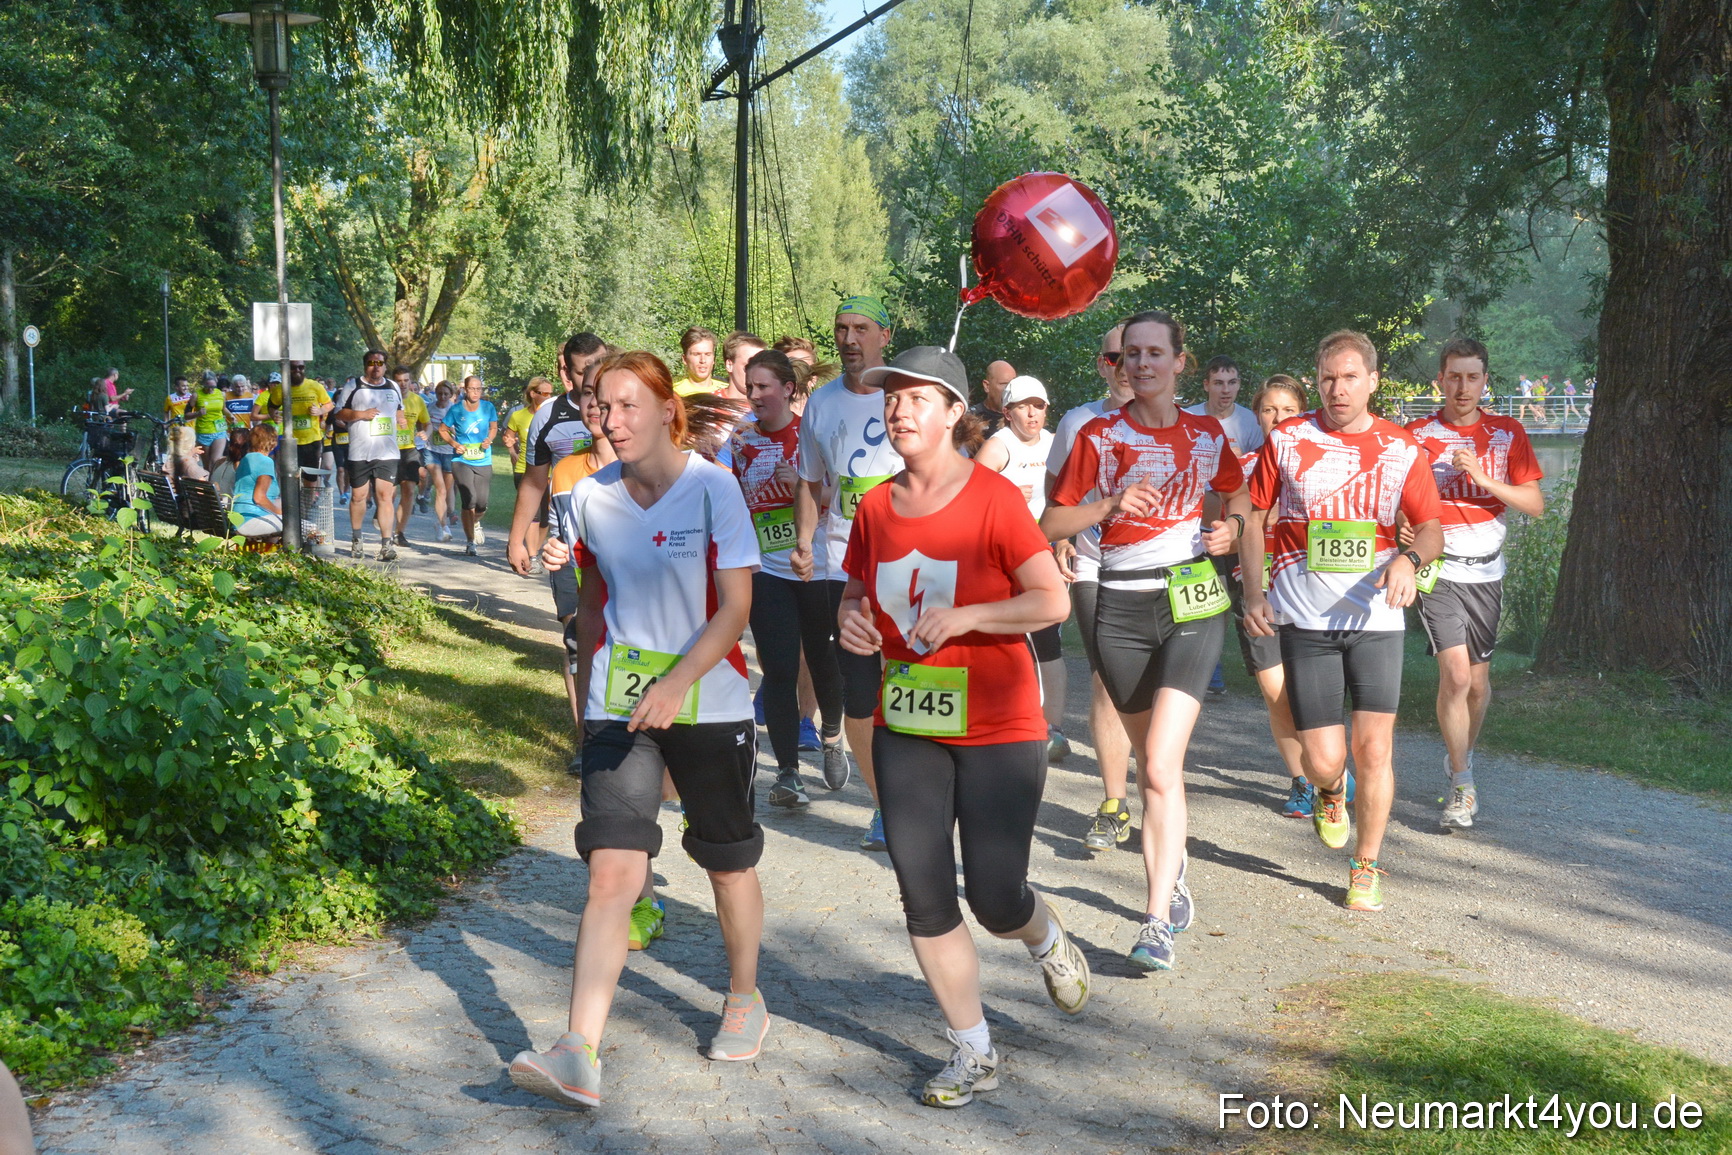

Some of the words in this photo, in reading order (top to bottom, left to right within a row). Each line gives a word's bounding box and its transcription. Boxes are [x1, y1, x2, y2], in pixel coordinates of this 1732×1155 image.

[996, 212, 1026, 247] DEHN
[378, 423, 391, 431] 375
[666, 550, 698, 559] Verena
[1317, 538, 1367, 558] 1836
[1188, 603, 1206, 611] Luber
[889, 686, 954, 717] 2145
